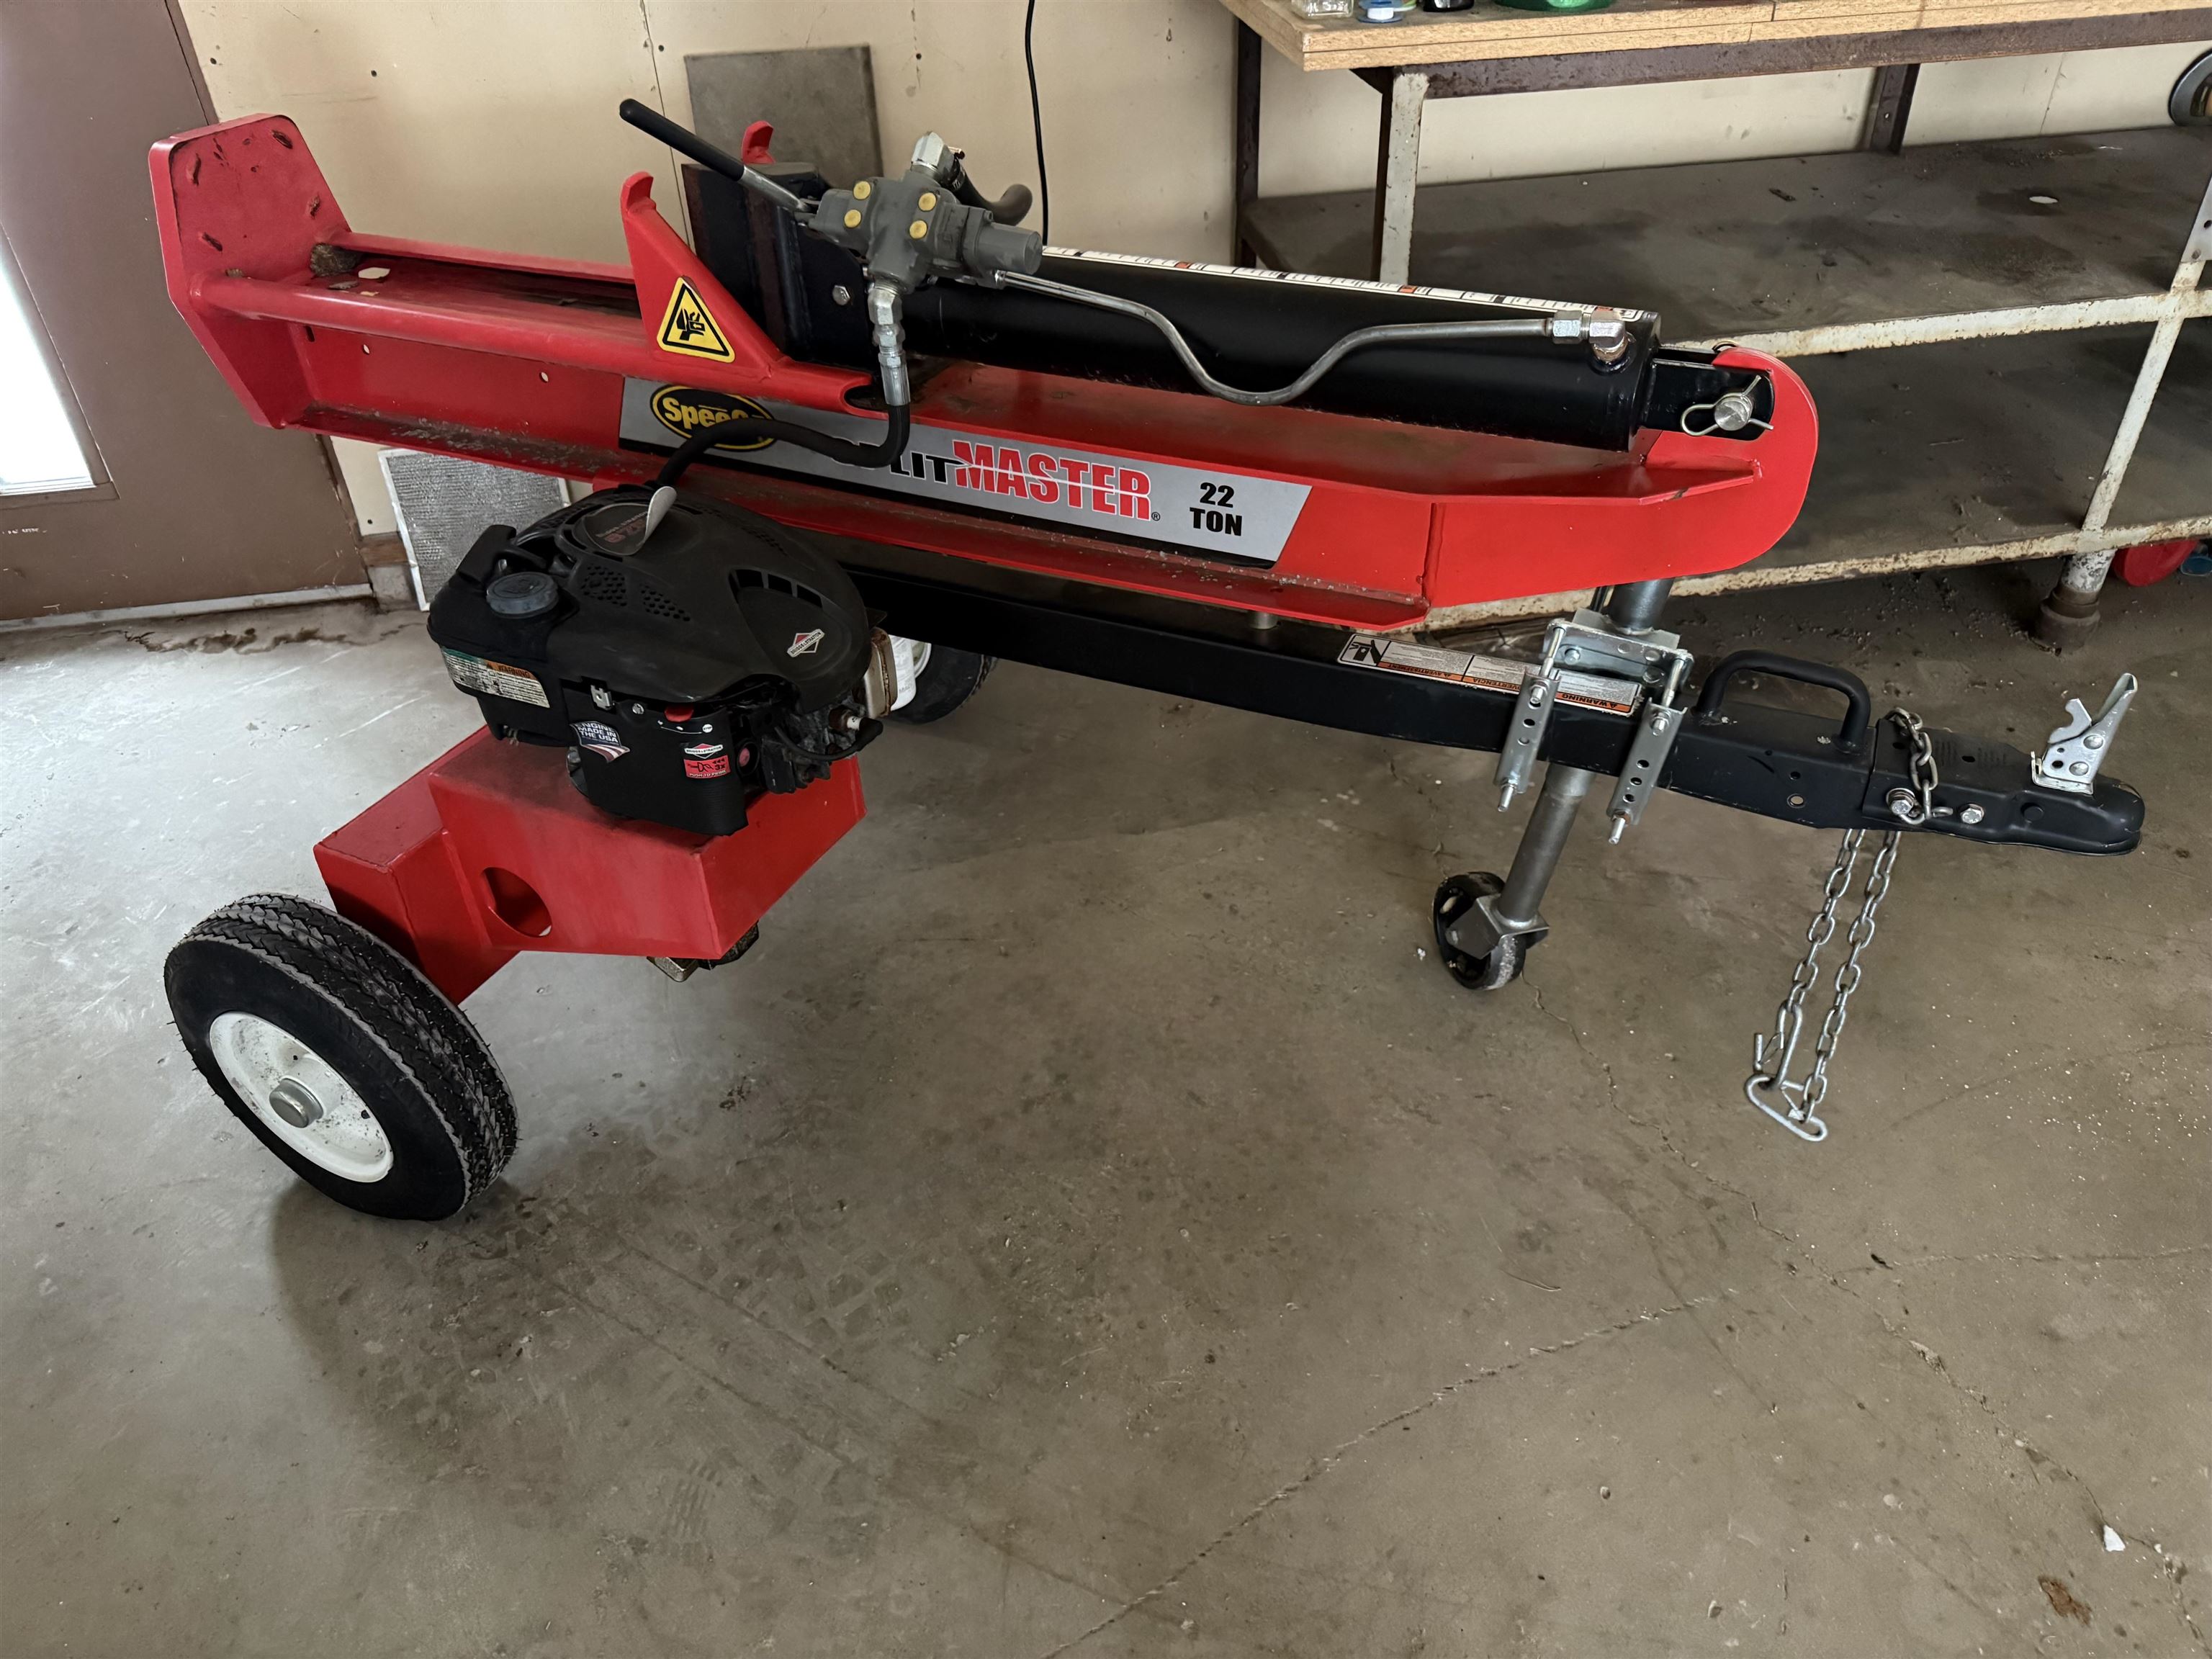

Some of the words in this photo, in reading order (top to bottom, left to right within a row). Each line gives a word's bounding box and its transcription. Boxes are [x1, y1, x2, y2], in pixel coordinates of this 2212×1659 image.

[1200, 482, 1235, 508] 22
[1189, 506, 1243, 536] TON
[1561, 693, 1608, 709] WARNING
[575, 723, 615, 732] ENGINE
[577, 727, 606, 735] MADE
[598, 734, 619, 743] USA
